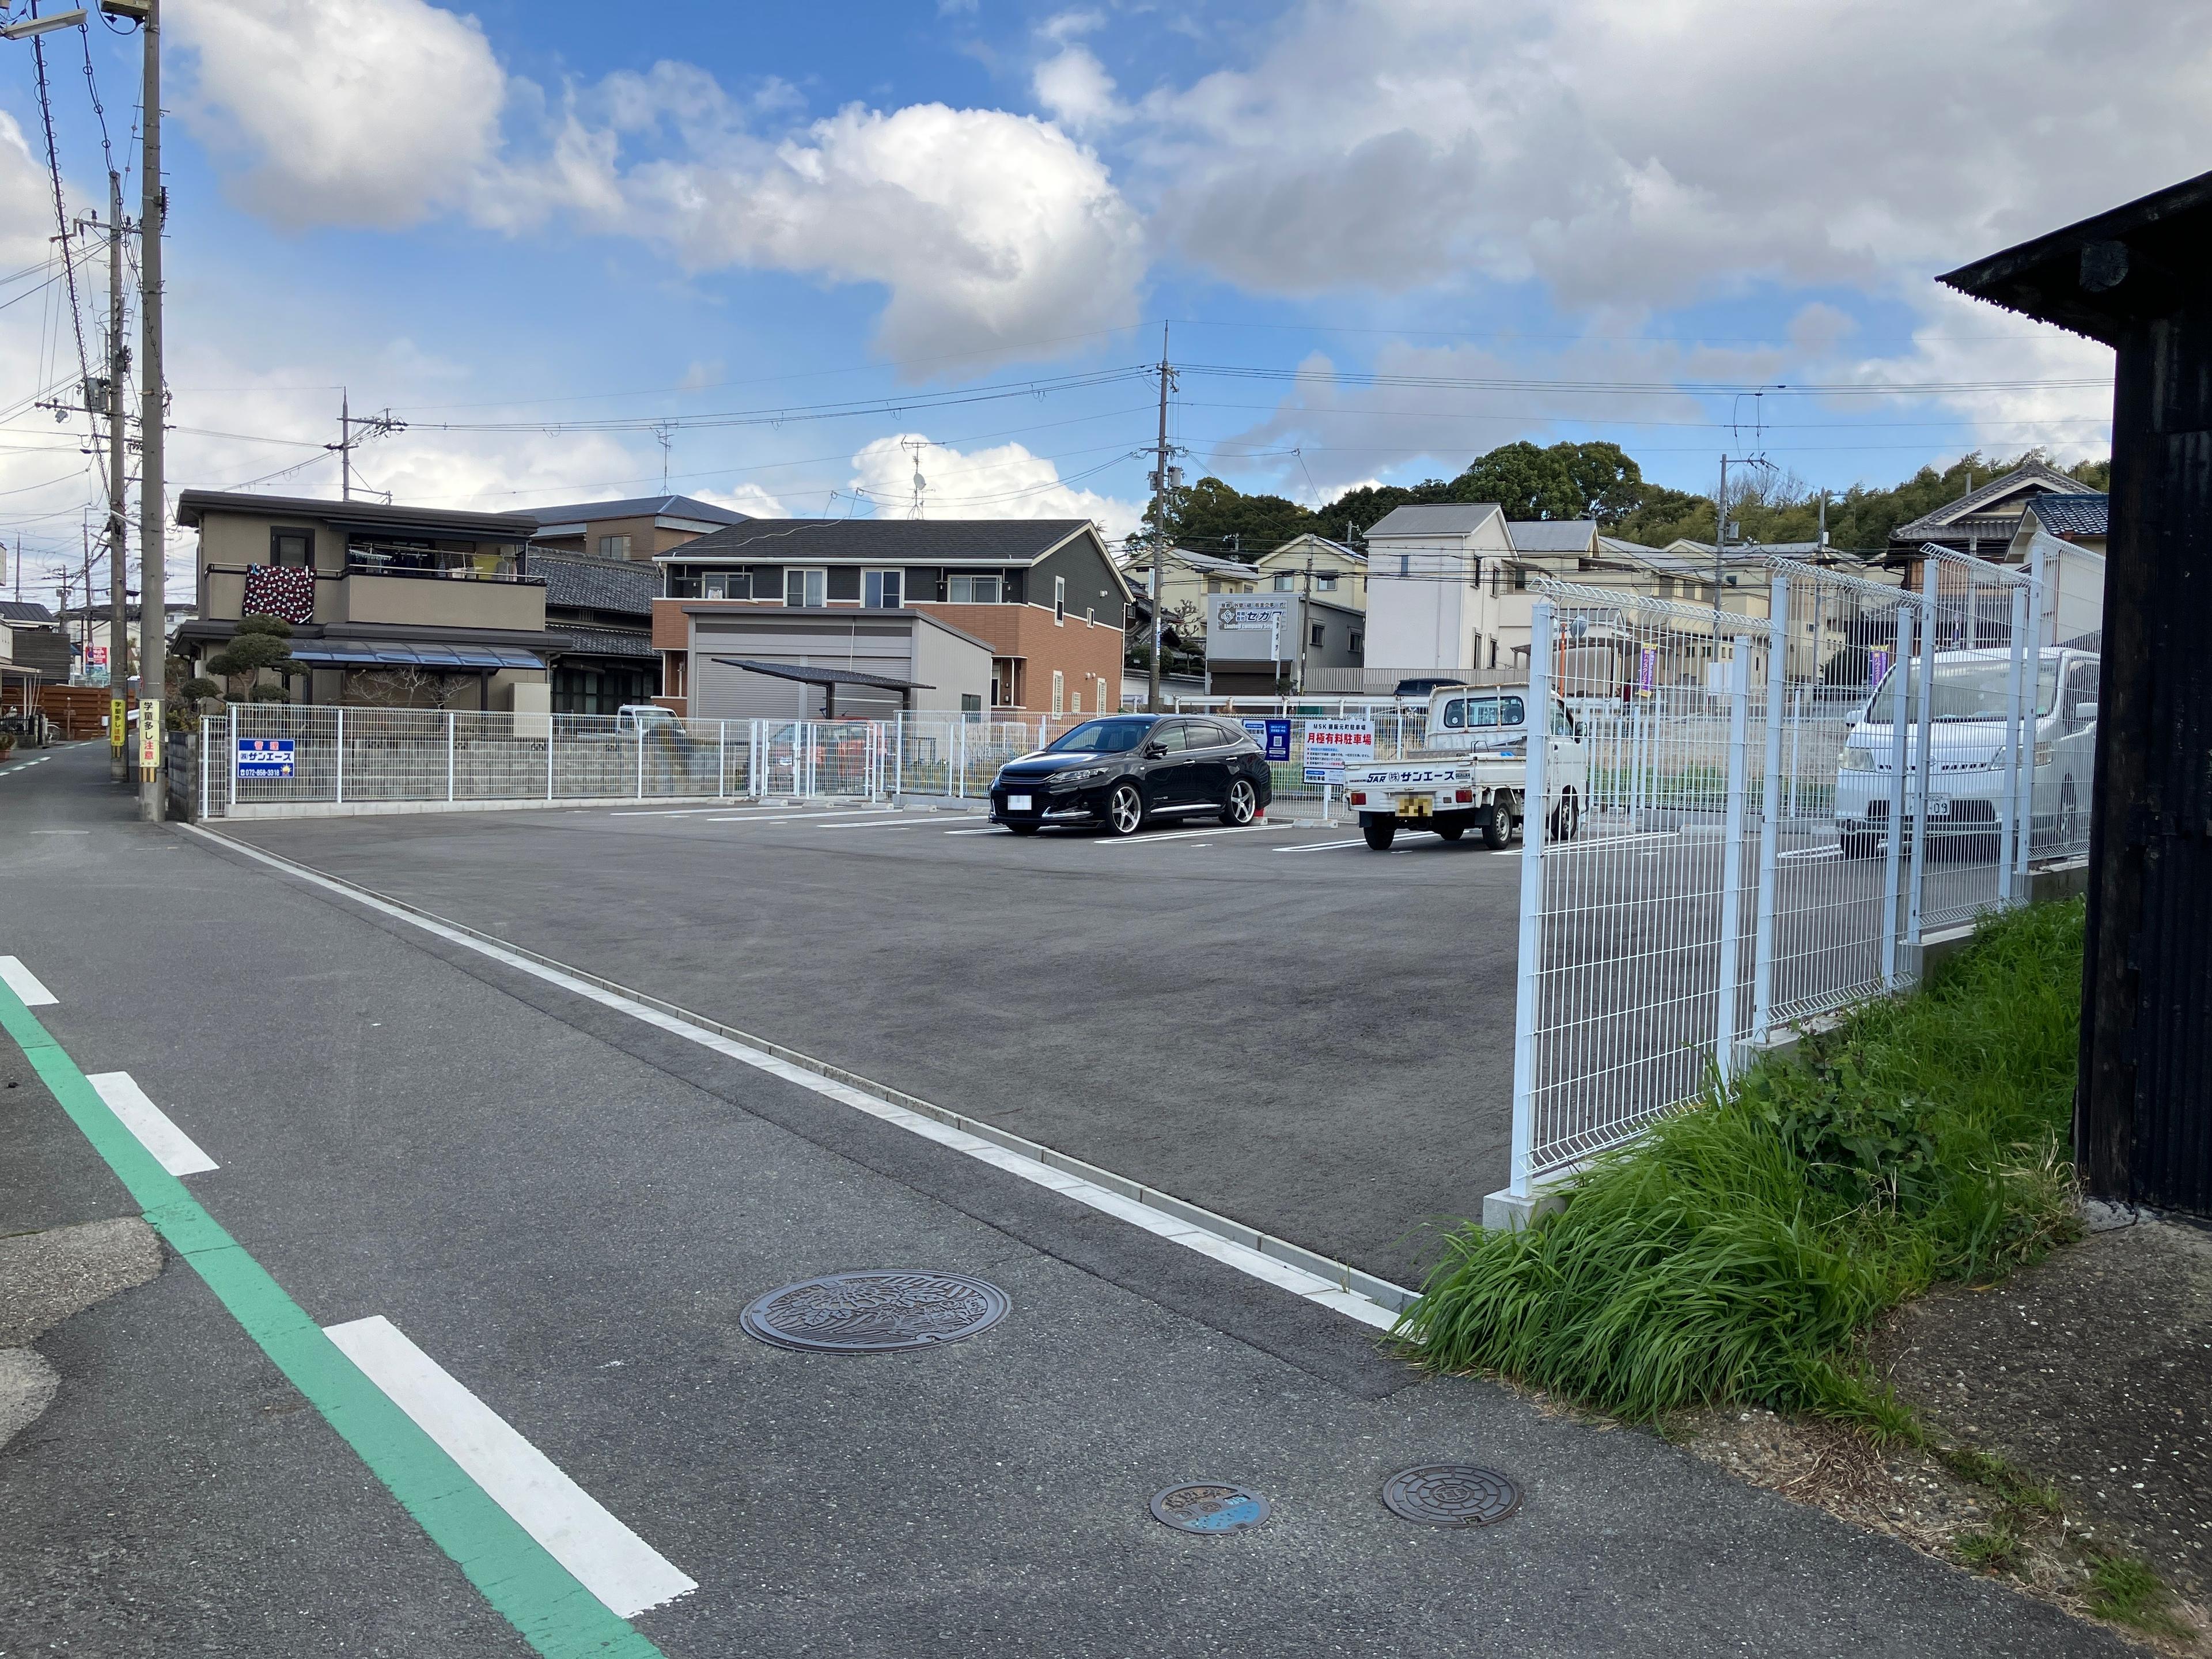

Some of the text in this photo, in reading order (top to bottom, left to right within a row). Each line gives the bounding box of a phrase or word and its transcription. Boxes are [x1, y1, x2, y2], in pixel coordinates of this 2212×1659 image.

[1307, 733, 1372, 745] 月極有料駐車場
